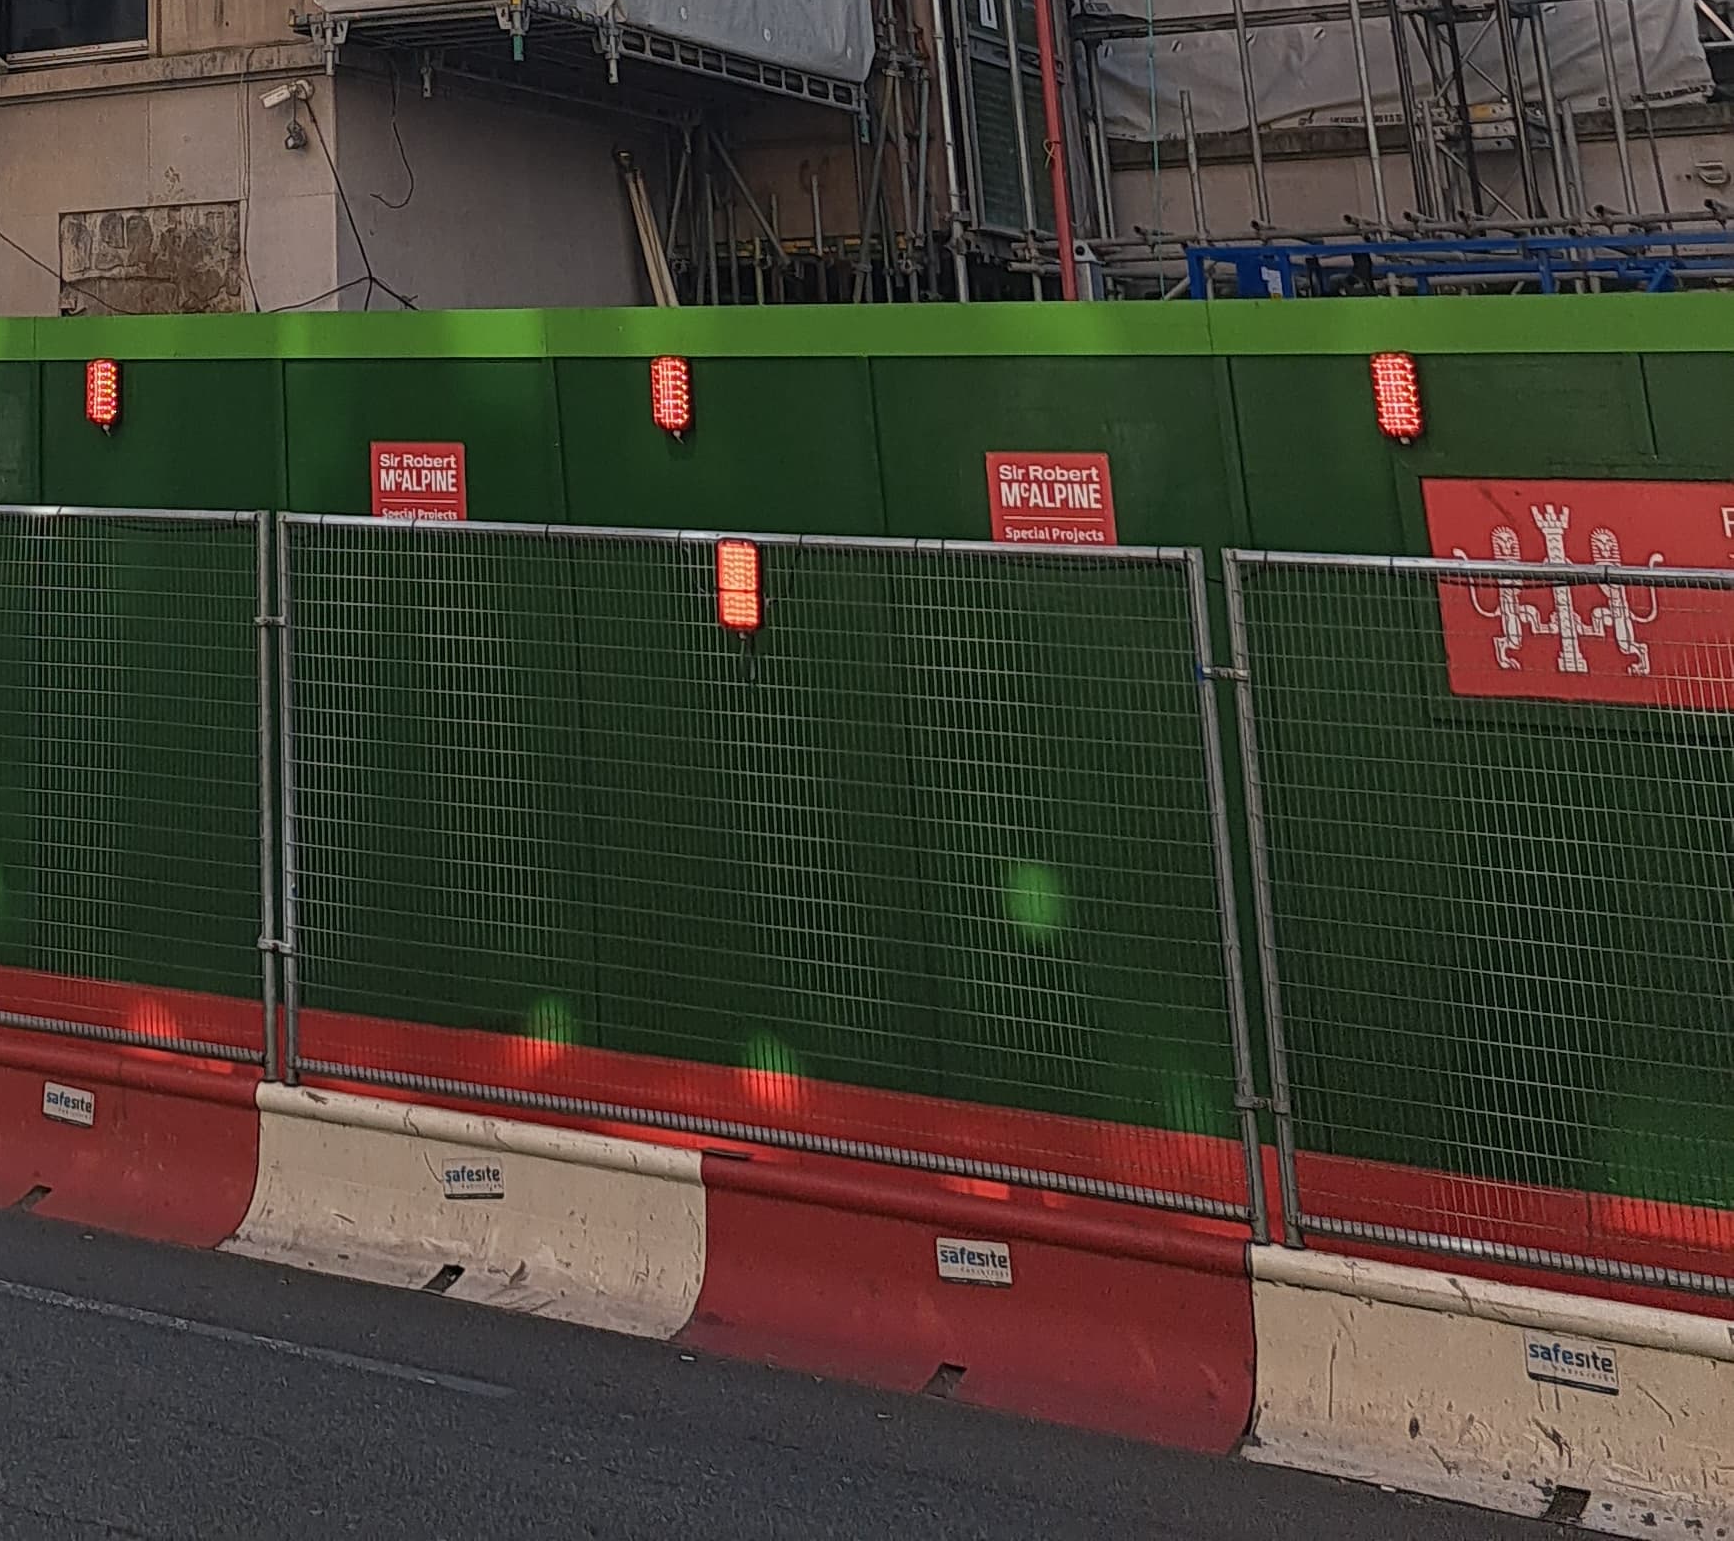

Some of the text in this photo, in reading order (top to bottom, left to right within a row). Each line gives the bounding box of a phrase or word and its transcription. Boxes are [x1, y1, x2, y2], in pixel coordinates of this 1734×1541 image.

[379, 453, 457, 468] Sir Robert
[380, 468, 458, 492] McALPINE
[998, 464, 1101, 482] Sir Robert
[1000, 482, 1103, 509] McALPINE
[381, 507, 416, 519] Special
[1005, 526, 1105, 544] Special Projects
[46, 1091, 92, 1114] safesite
[445, 1165, 501, 1182] safesite
[939, 1246, 1008, 1269] safesite
[1528, 1342, 1614, 1373] safesite
